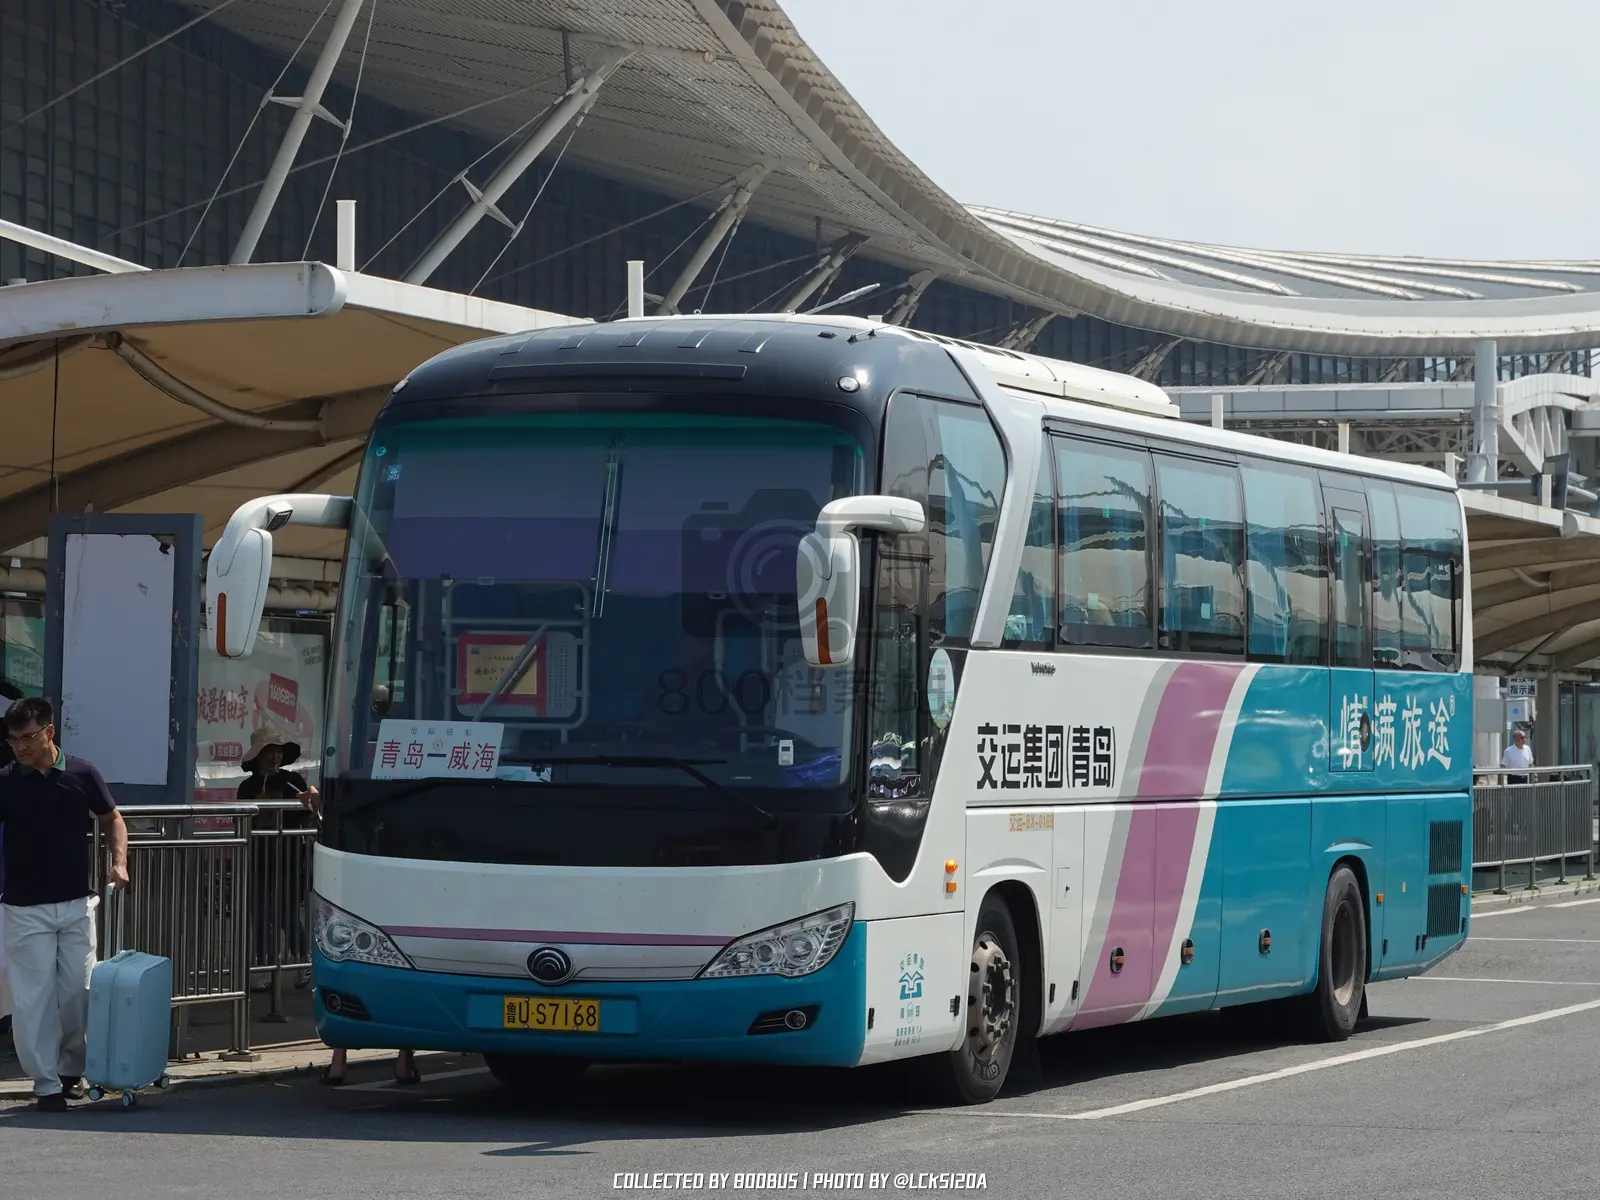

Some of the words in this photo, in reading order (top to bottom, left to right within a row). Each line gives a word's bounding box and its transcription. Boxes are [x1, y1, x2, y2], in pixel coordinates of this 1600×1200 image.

[976, 722, 1116, 789] 交运集团(青岛)
[1340, 693, 1452, 771] 情满旅途
